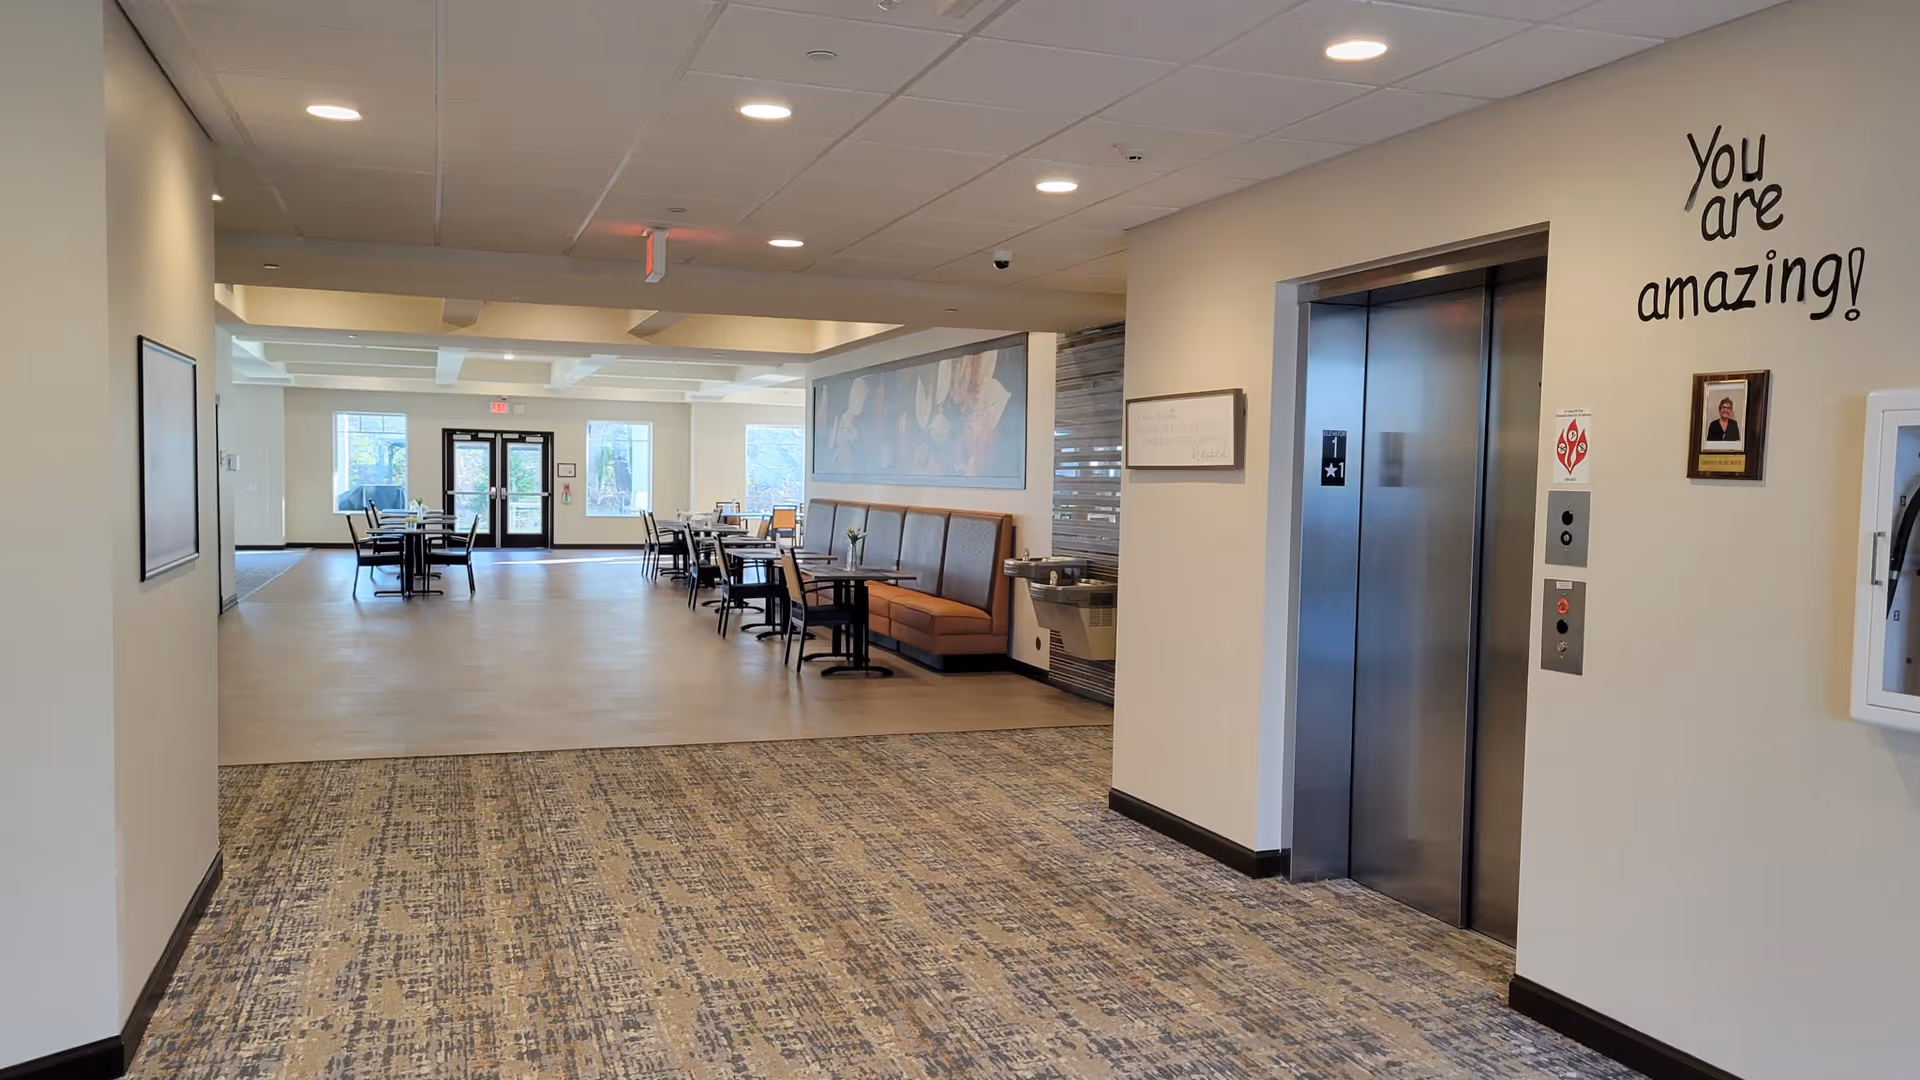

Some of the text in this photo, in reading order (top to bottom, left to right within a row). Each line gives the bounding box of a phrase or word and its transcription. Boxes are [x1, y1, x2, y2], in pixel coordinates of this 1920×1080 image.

[1684, 125, 1766, 213] You
[1701, 183, 1784, 241] are
[1638, 247, 1865, 322] amazing!
[1332, 436, 1338, 458] 1
